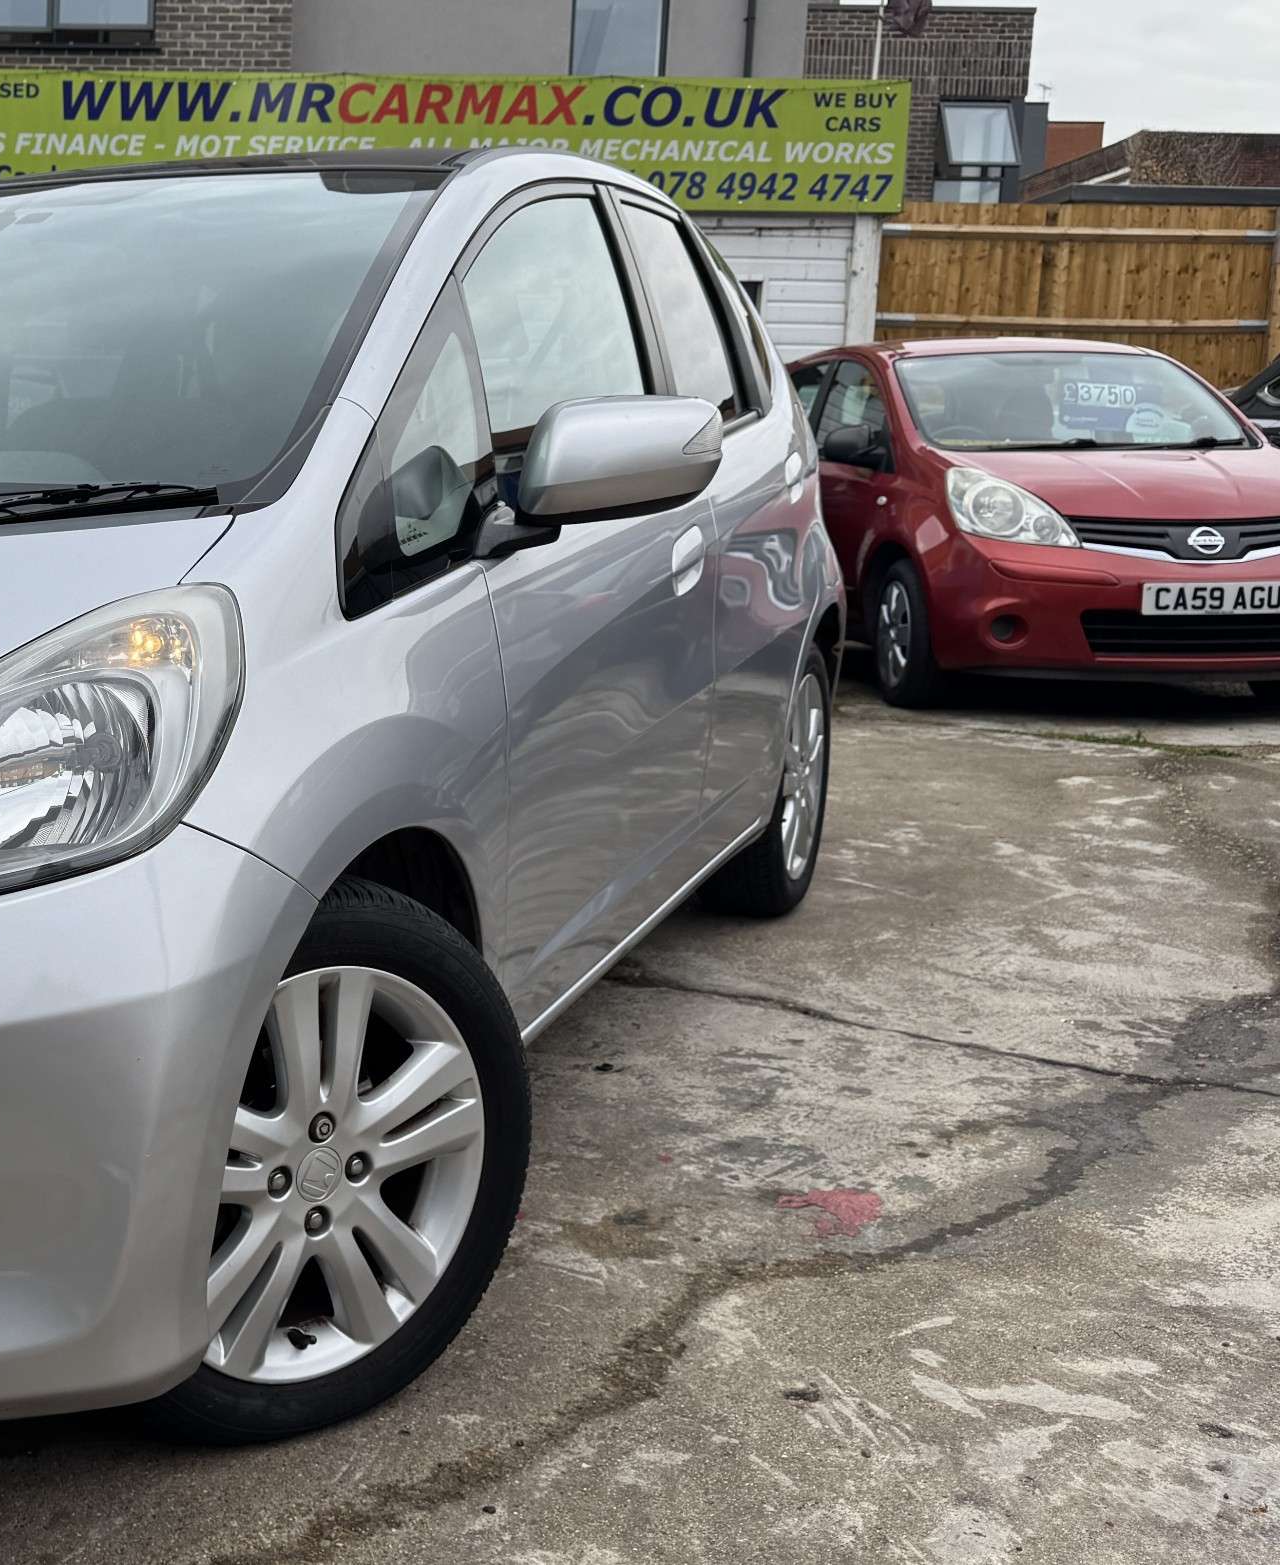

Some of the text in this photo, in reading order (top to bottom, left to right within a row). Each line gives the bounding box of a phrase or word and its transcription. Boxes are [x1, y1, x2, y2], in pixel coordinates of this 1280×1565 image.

[61, 79, 789, 129] WWW.MRCARMAX.CO.UK
[813, 92, 897, 109] WE BUY
[825, 116, 881, 132] CARS
[14, 133, 146, 157] FINANCE
[175, 135, 241, 157] MOT
[247, 136, 376, 156] SERVICE
[578, 138, 772, 163] MECHANICAL
[784, 142, 895, 164] WORKS
[716, 171, 798, 201] 4942
[808, 173, 893, 202] 4747
[1155, 586, 1280, 610] CA59 AGU
